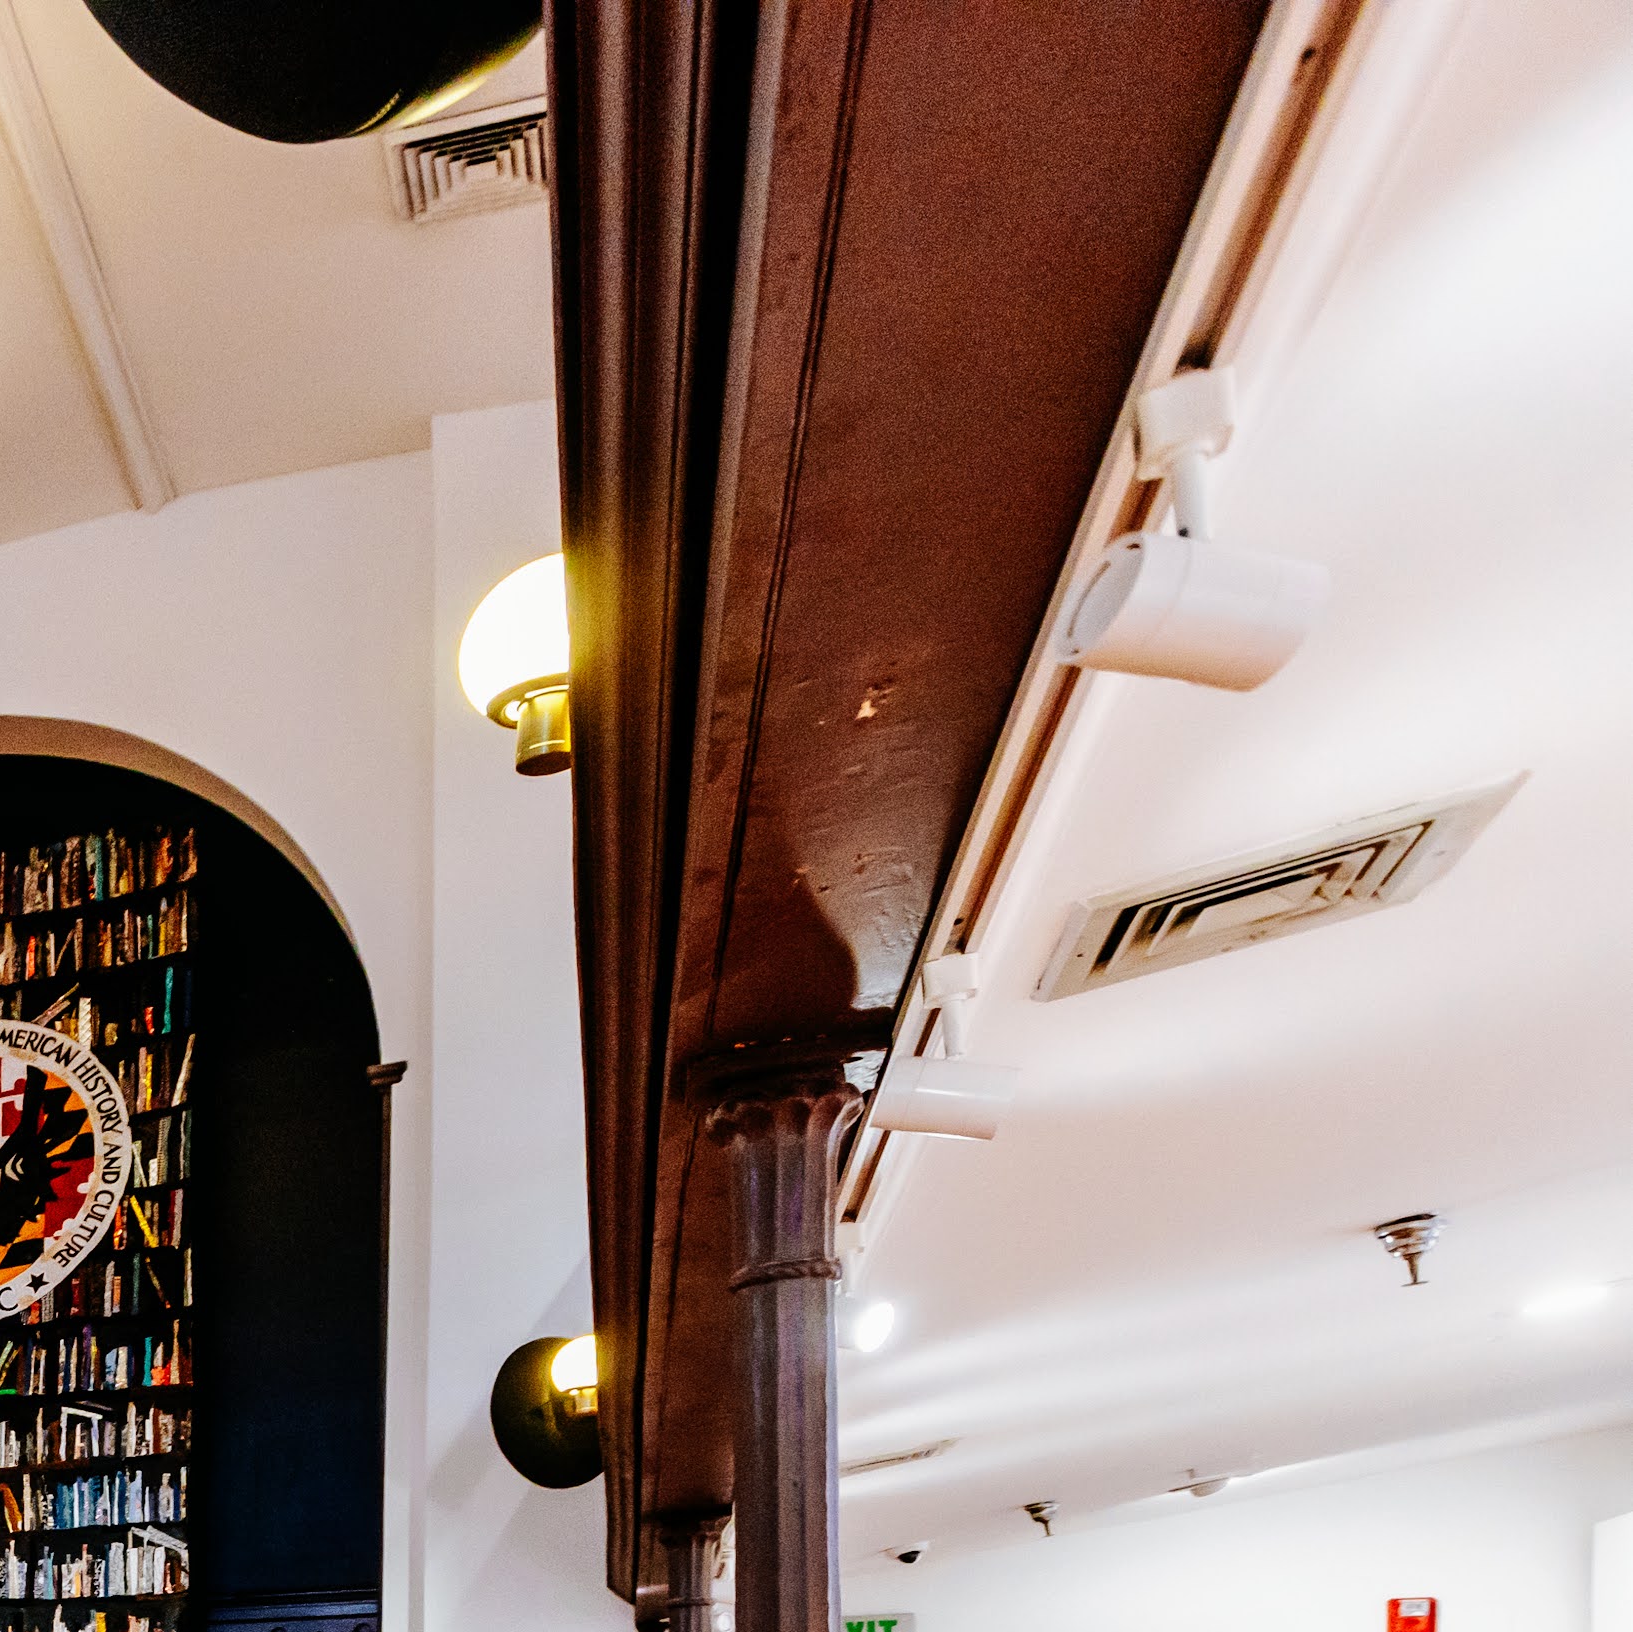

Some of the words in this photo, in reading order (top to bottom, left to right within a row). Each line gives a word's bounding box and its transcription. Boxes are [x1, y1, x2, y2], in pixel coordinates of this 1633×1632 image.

[72, 1057, 123, 1134] HISTORY
[101, 1142, 121, 1184] AND
[53, 1189, 115, 1267] CULTURE
